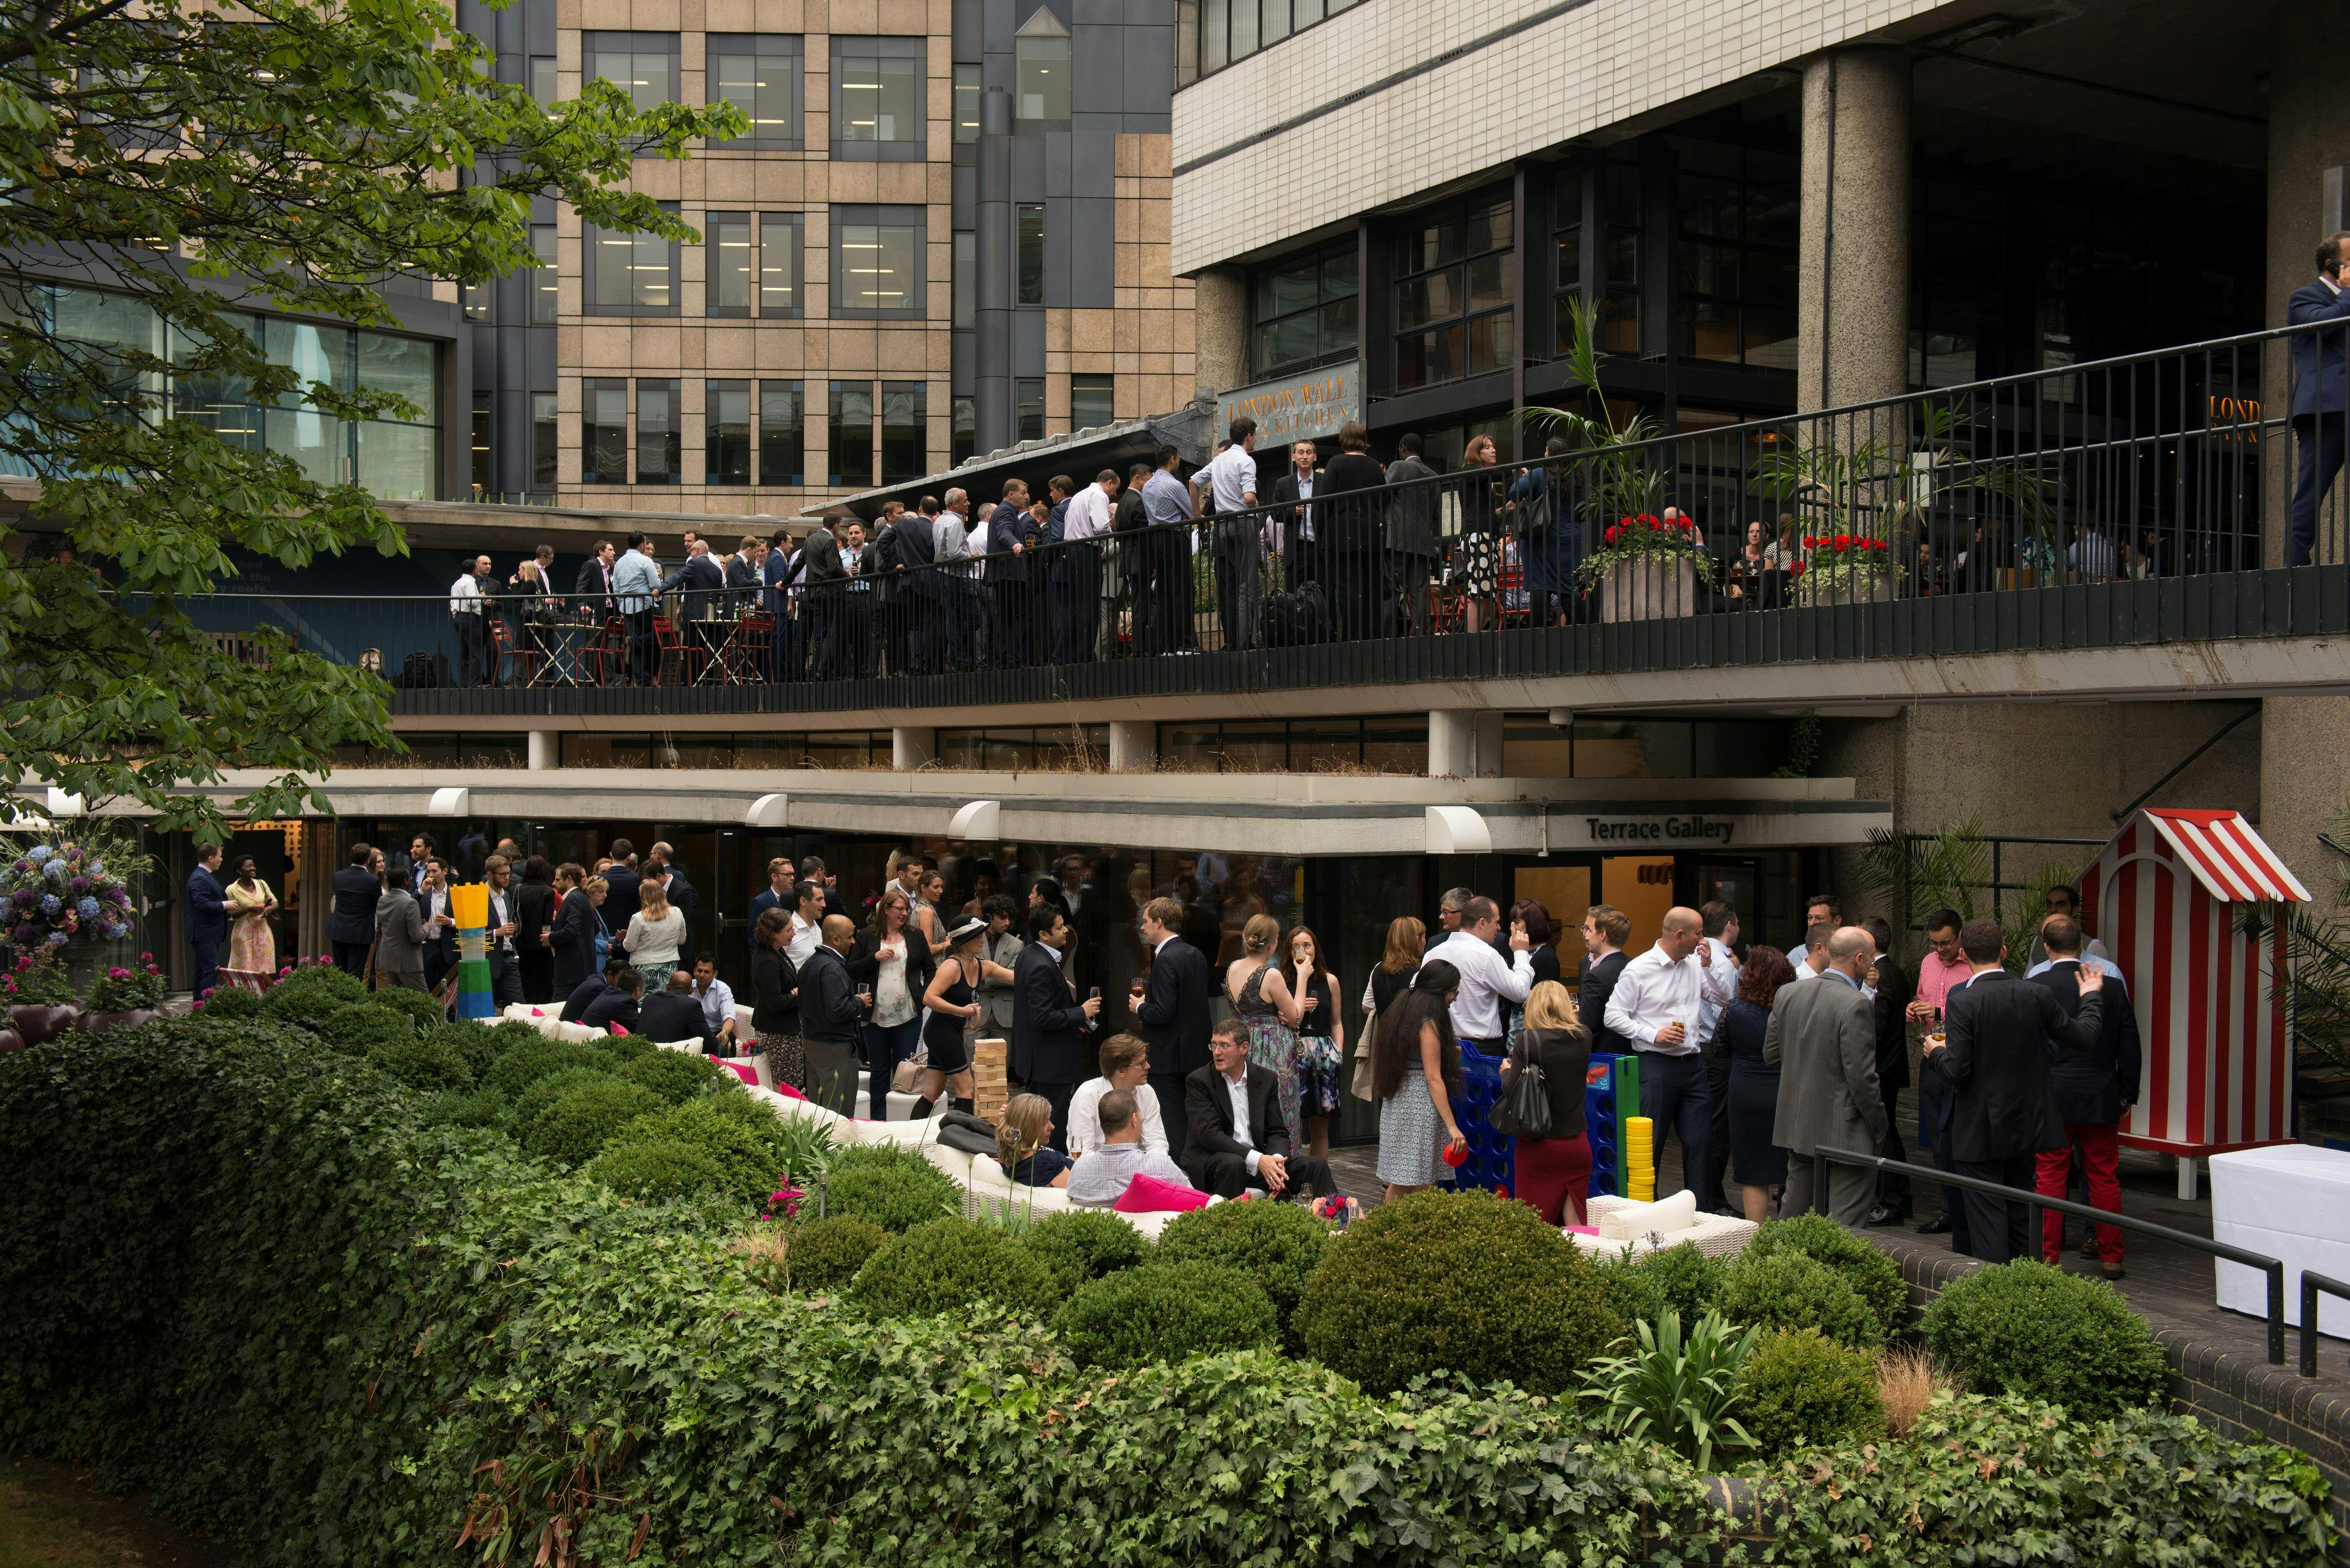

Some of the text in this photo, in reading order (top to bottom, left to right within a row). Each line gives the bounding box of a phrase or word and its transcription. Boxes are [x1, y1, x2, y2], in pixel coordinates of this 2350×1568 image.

[1227, 376, 1347, 423] LONDON WALL
[2210, 396, 2265, 423] LOND
[1261, 403, 1348, 437] & KITCHEN
[250, 572, 271, 582] the
[1586, 816, 1735, 844] Terrace Gallery
